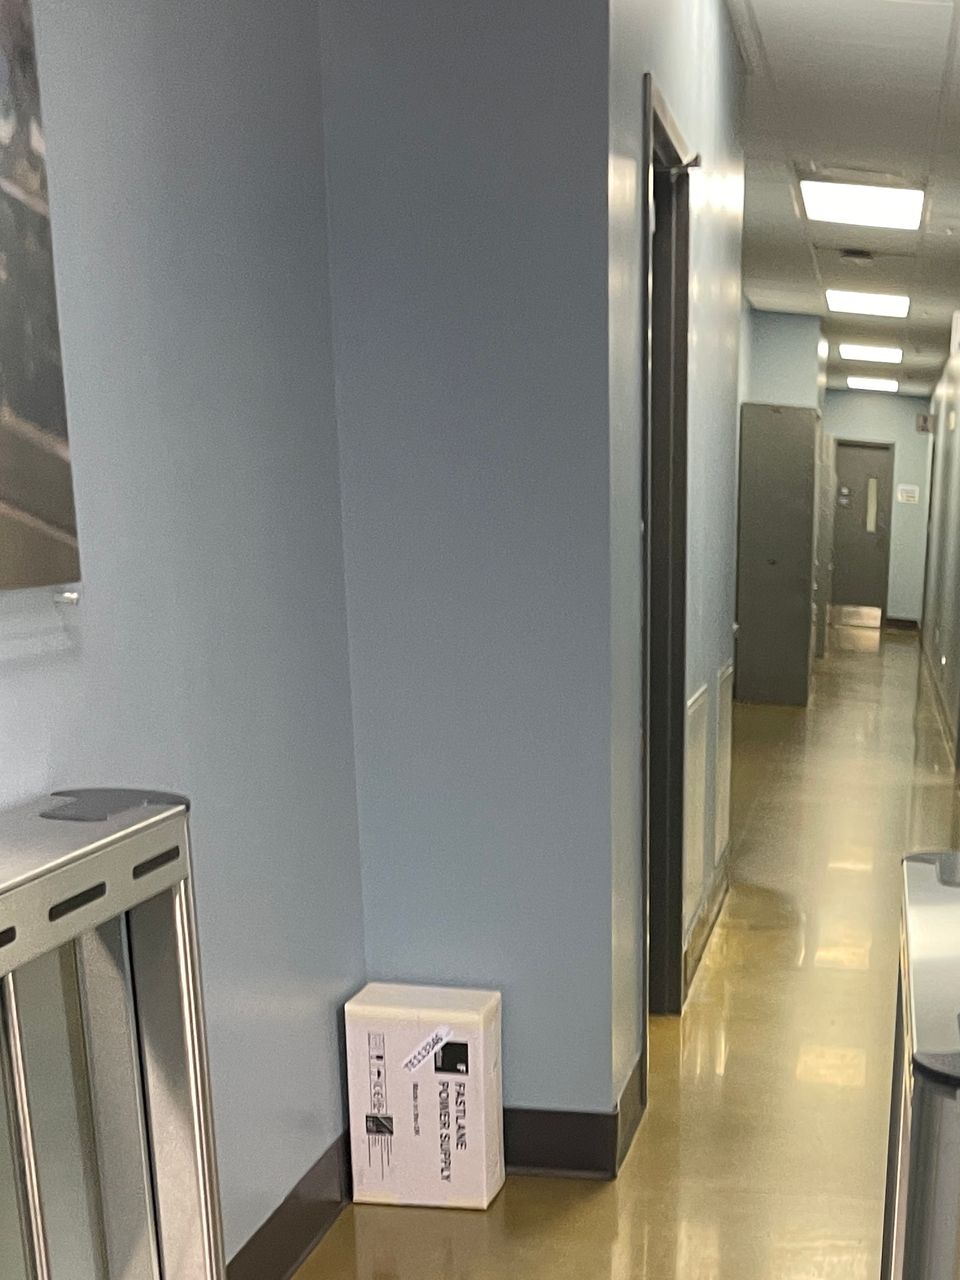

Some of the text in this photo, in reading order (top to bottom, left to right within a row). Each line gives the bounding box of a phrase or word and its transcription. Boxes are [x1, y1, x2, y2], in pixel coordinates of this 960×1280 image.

[439, 1080, 450, 1130] POWER
[455, 1081, 466, 1150] FASTLANE
[440, 1133, 451, 1182] SUPPLY
